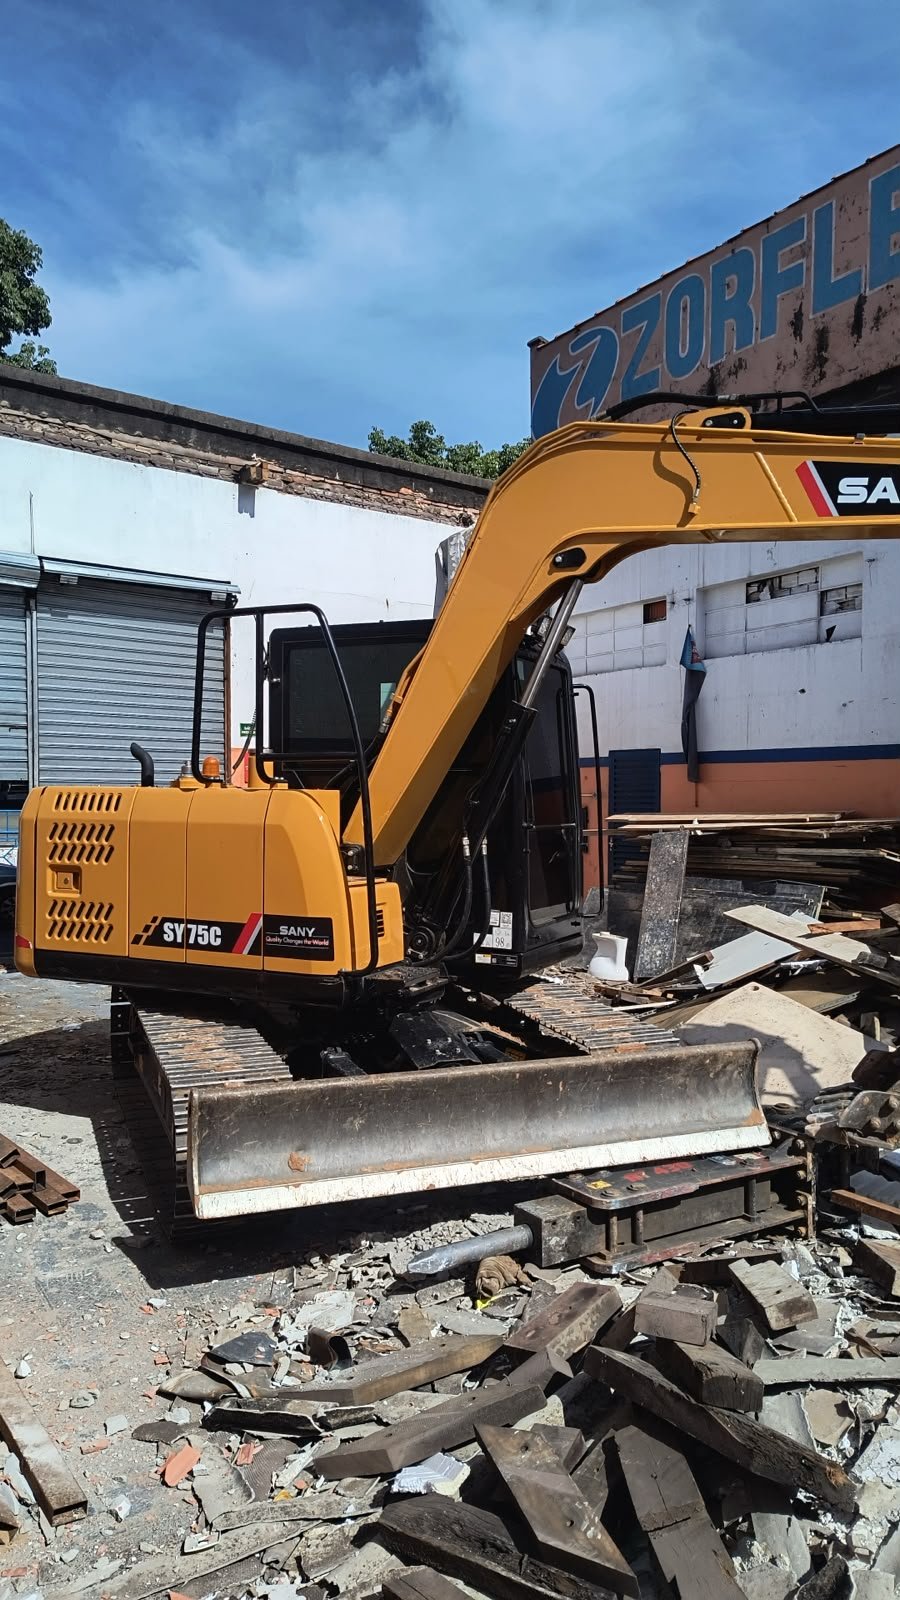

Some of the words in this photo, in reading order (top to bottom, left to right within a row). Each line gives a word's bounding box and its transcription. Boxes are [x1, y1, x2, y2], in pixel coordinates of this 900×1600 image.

[836, 477, 900, 504] SA
[163, 922, 222, 946] SY75C
[265, 935, 282, 944] Quality
[282, 936, 304, 946] Changes
[312, 938, 330, 946] World
[279, 925, 316, 938] SANY
